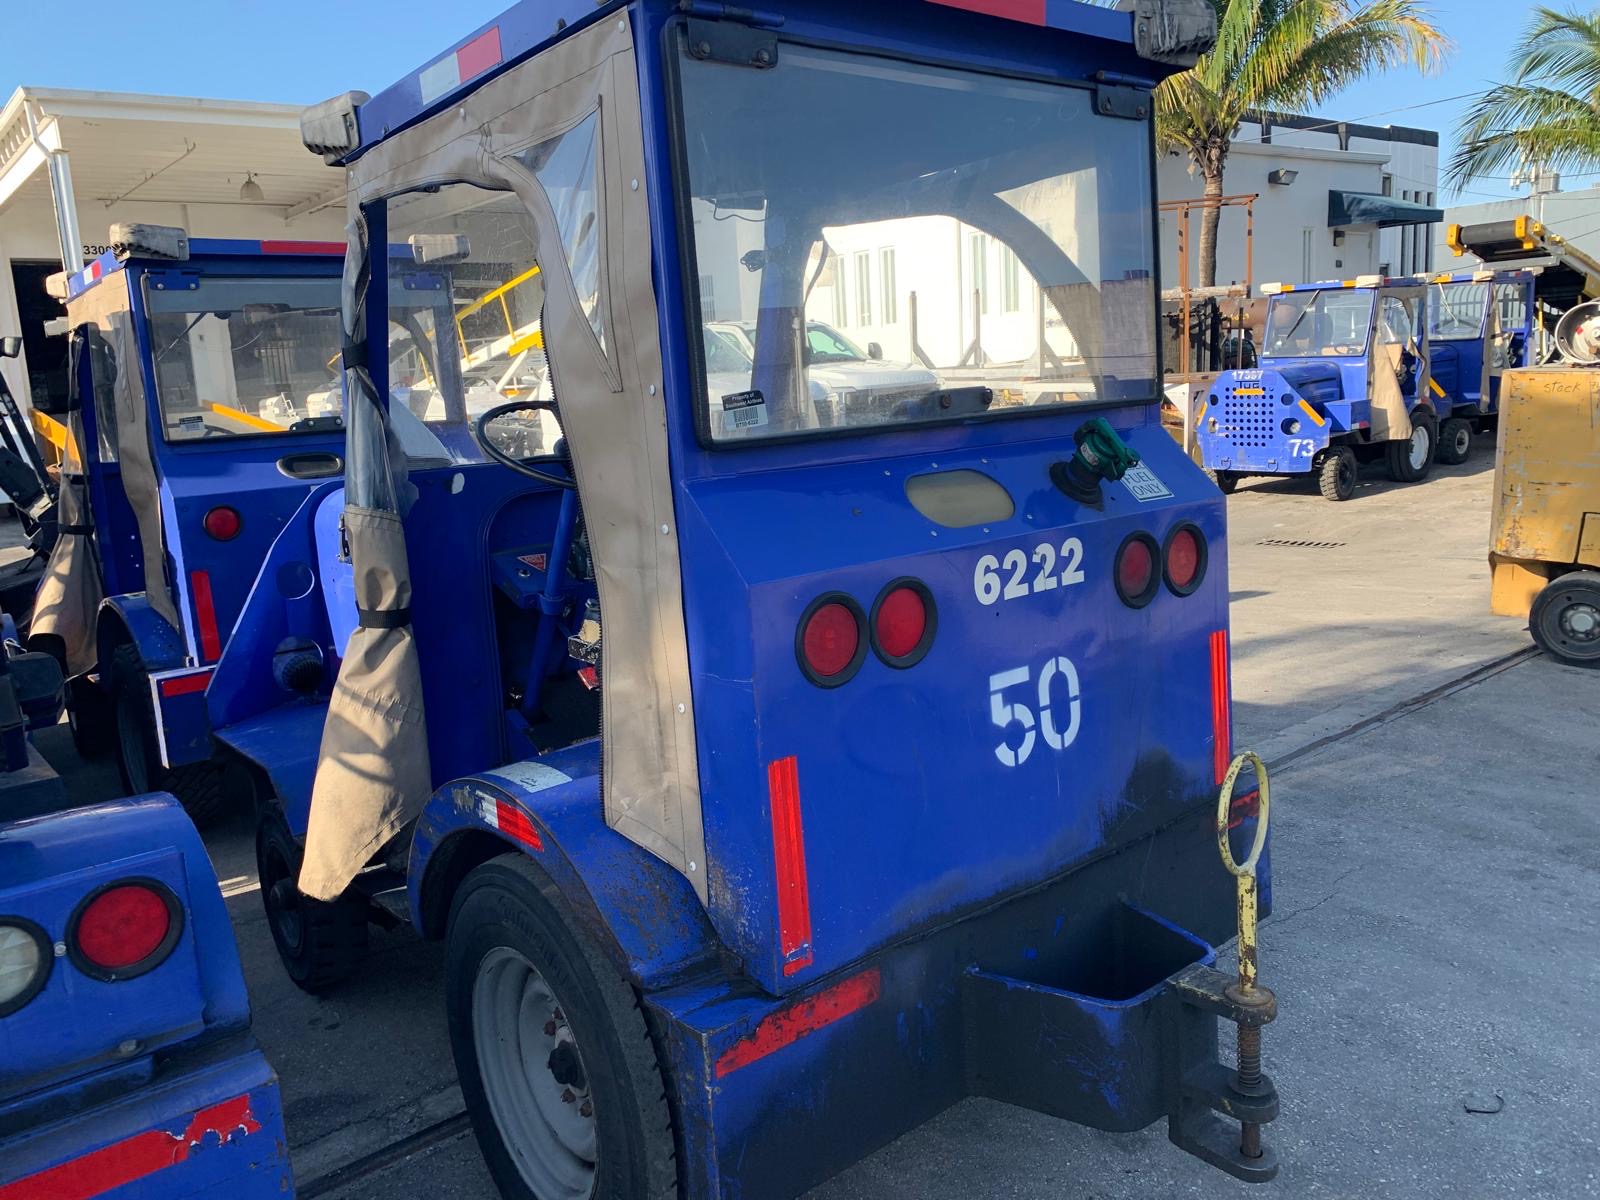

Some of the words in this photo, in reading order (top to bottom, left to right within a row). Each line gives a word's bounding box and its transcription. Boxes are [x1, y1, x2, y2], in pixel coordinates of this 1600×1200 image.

[1289, 438, 1315, 457] 73
[1132, 483, 1163, 496] ONLY
[974, 537, 1085, 605] 6222
[989, 656, 1081, 767] 50
